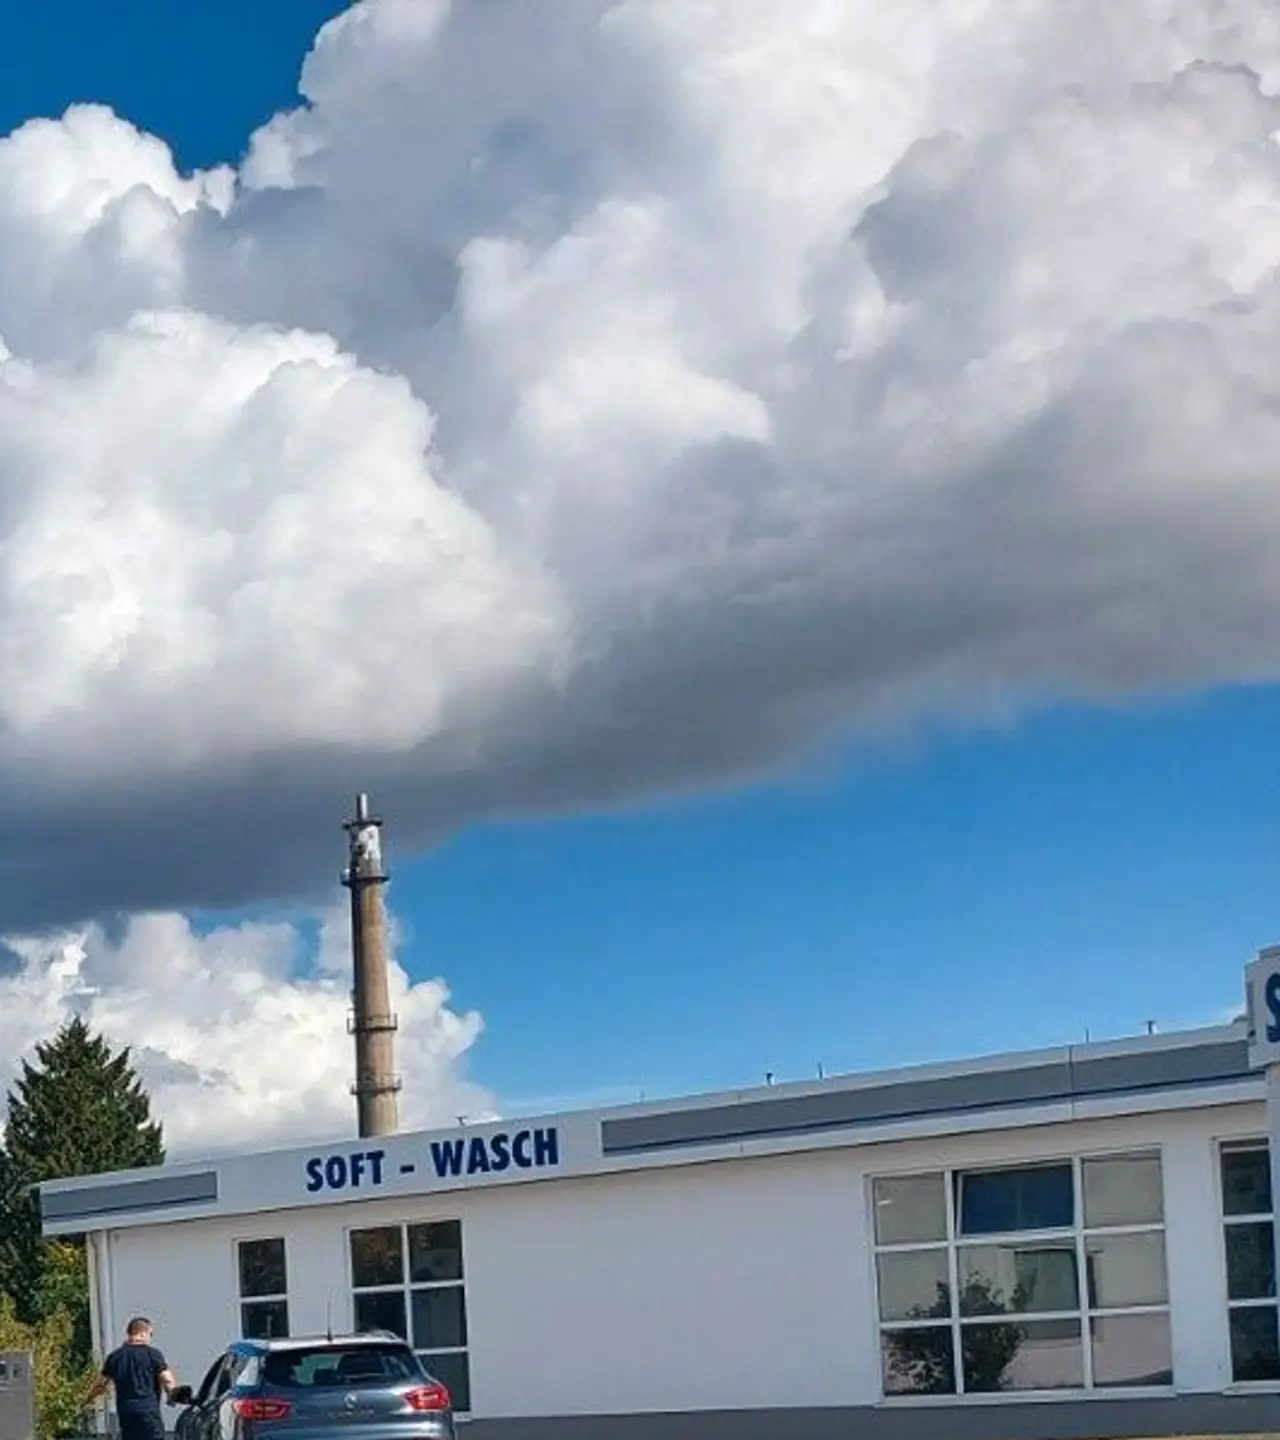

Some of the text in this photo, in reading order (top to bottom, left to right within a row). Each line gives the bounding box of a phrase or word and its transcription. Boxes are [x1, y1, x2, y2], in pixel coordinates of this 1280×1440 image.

[305, 1127, 559, 1193] SOFT - WASCH
